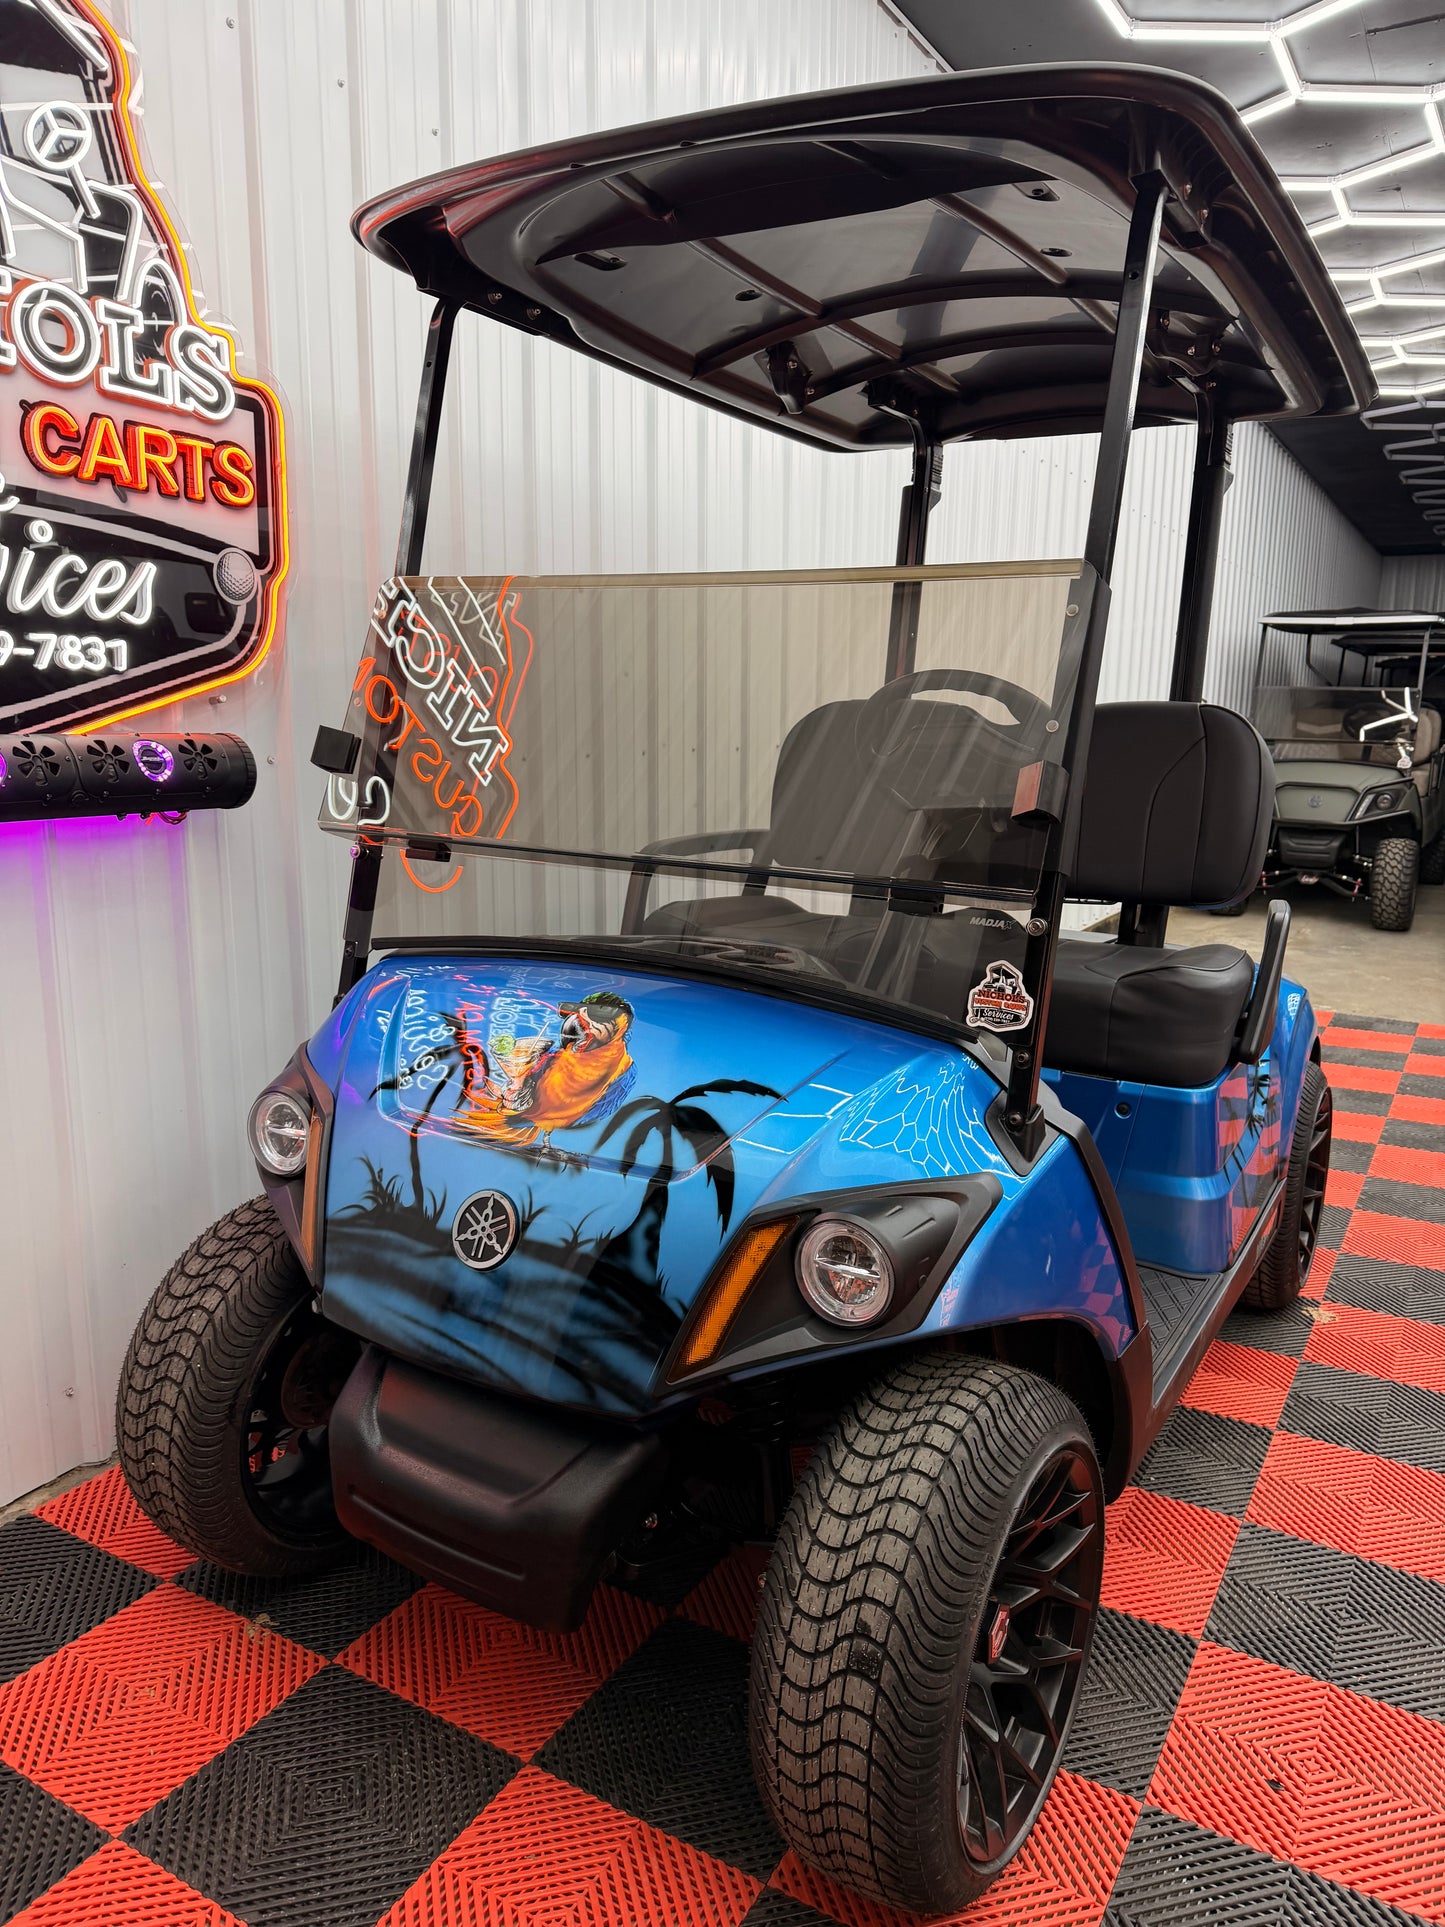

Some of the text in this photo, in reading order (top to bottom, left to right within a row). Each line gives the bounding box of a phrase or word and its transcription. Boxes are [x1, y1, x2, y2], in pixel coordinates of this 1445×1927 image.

[0, 265, 237, 424] OLS
[20, 402, 256, 509] CARTS
[969, 916, 1013, 931] MADJAX
[982, 1008, 1014, 1021] Services
